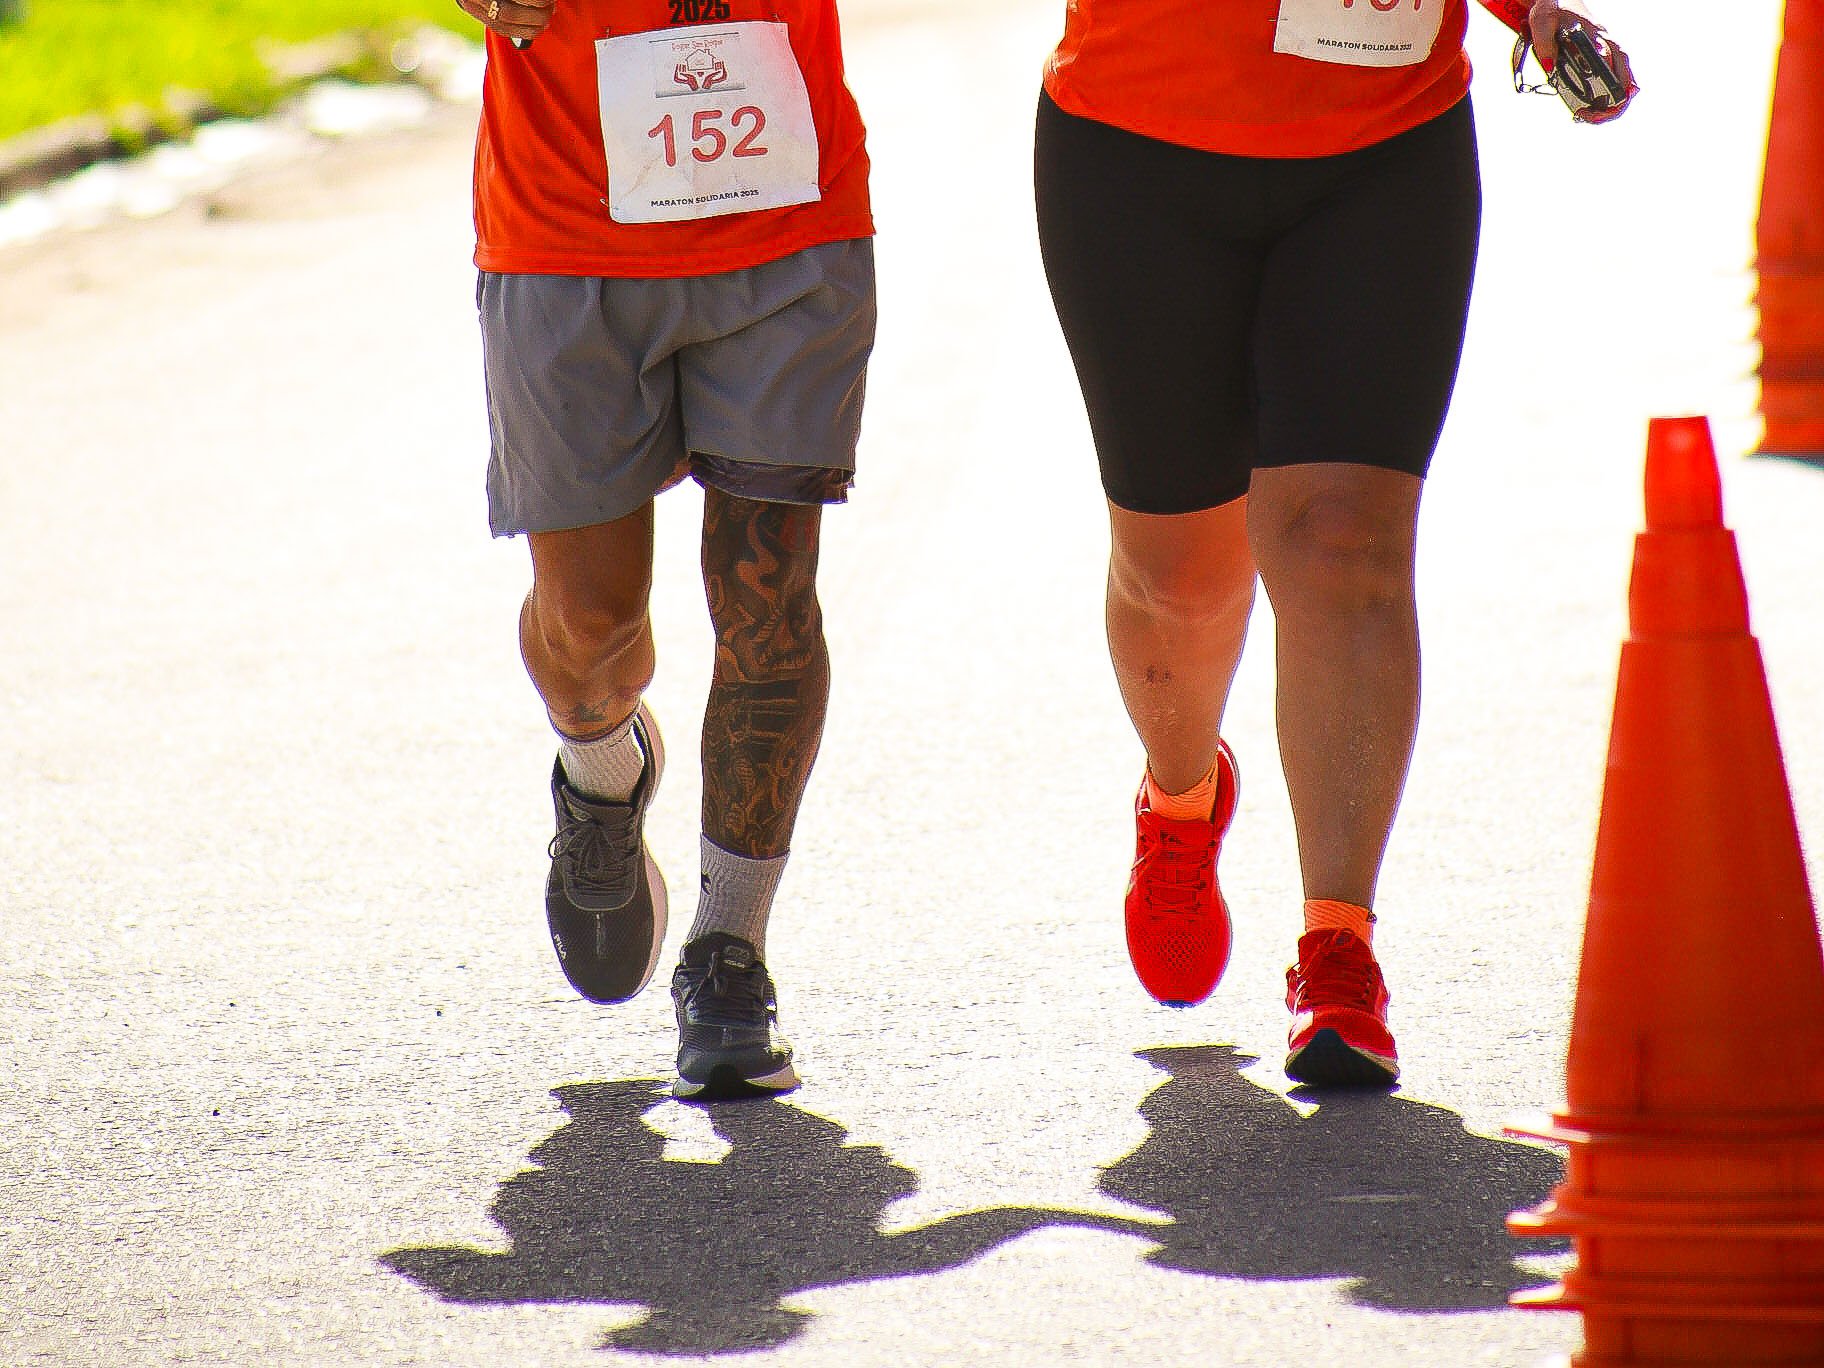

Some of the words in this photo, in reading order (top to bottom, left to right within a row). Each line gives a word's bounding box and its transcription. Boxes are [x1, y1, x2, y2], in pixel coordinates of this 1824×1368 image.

[1317, 37, 1361, 50] MARATON
[648, 105, 769, 168] 152
[650, 196, 694, 208] MARATON
[695, 191, 740, 204] SOLIDARIA
[740, 188, 760, 199] 2025
